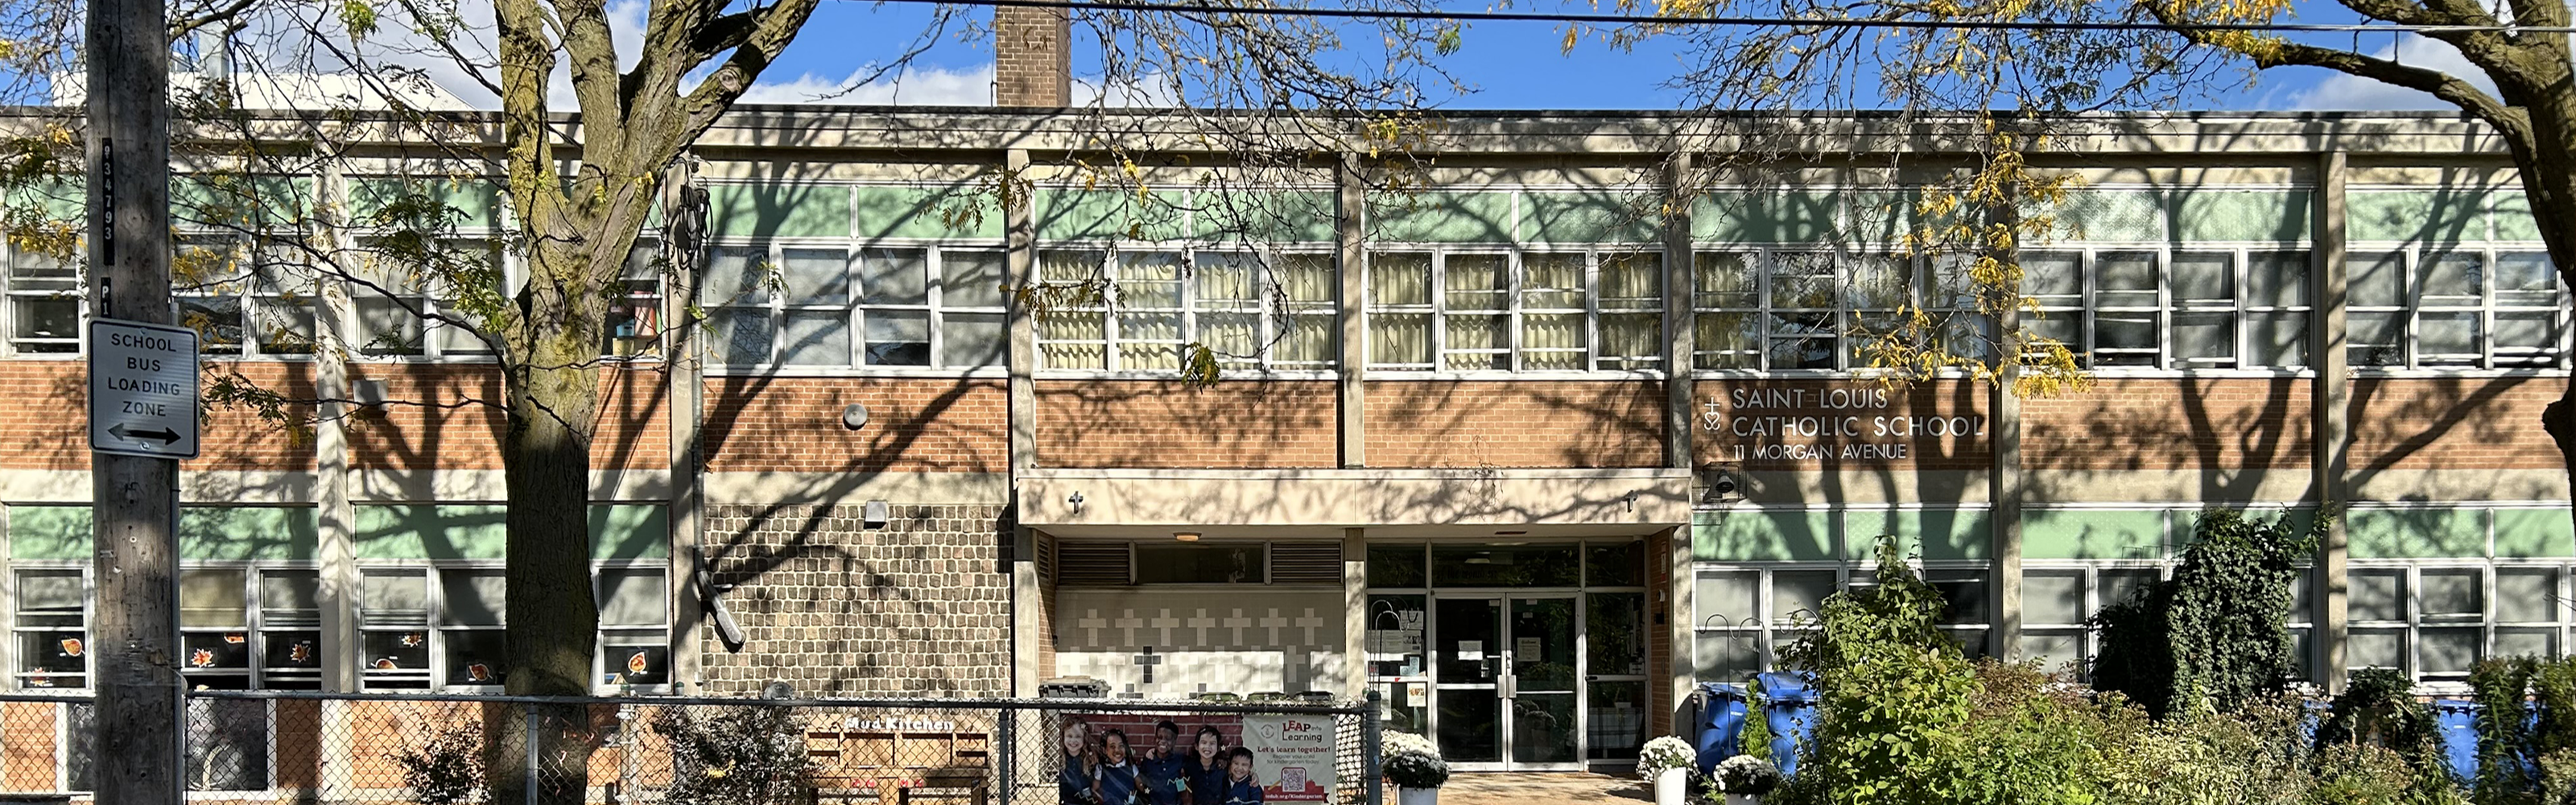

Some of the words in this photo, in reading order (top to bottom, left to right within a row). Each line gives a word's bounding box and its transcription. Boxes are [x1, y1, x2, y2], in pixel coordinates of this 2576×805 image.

[111, 333, 177, 352] SCHOOL
[127, 357, 161, 372] BUS
[108, 377, 180, 396] LOADING
[1732, 388, 1806, 409] SAINT
[1820, 388, 1888, 409] LOUIS
[123, 401, 166, 417] ZONE
[1732, 416, 1859, 437] CATHOLIC
[1873, 415, 1984, 437] SCHOOL
[1734, 444, 1744, 460] 11
[1752, 444, 1833, 460] MORGAN
[1841, 444, 1906, 460] AVENUE
[844, 716, 881, 730] Mud
[886, 716, 955, 730] Kitchen
[1282, 720, 1311, 732] LEAP
[1282, 731, 1322, 743] Learning
